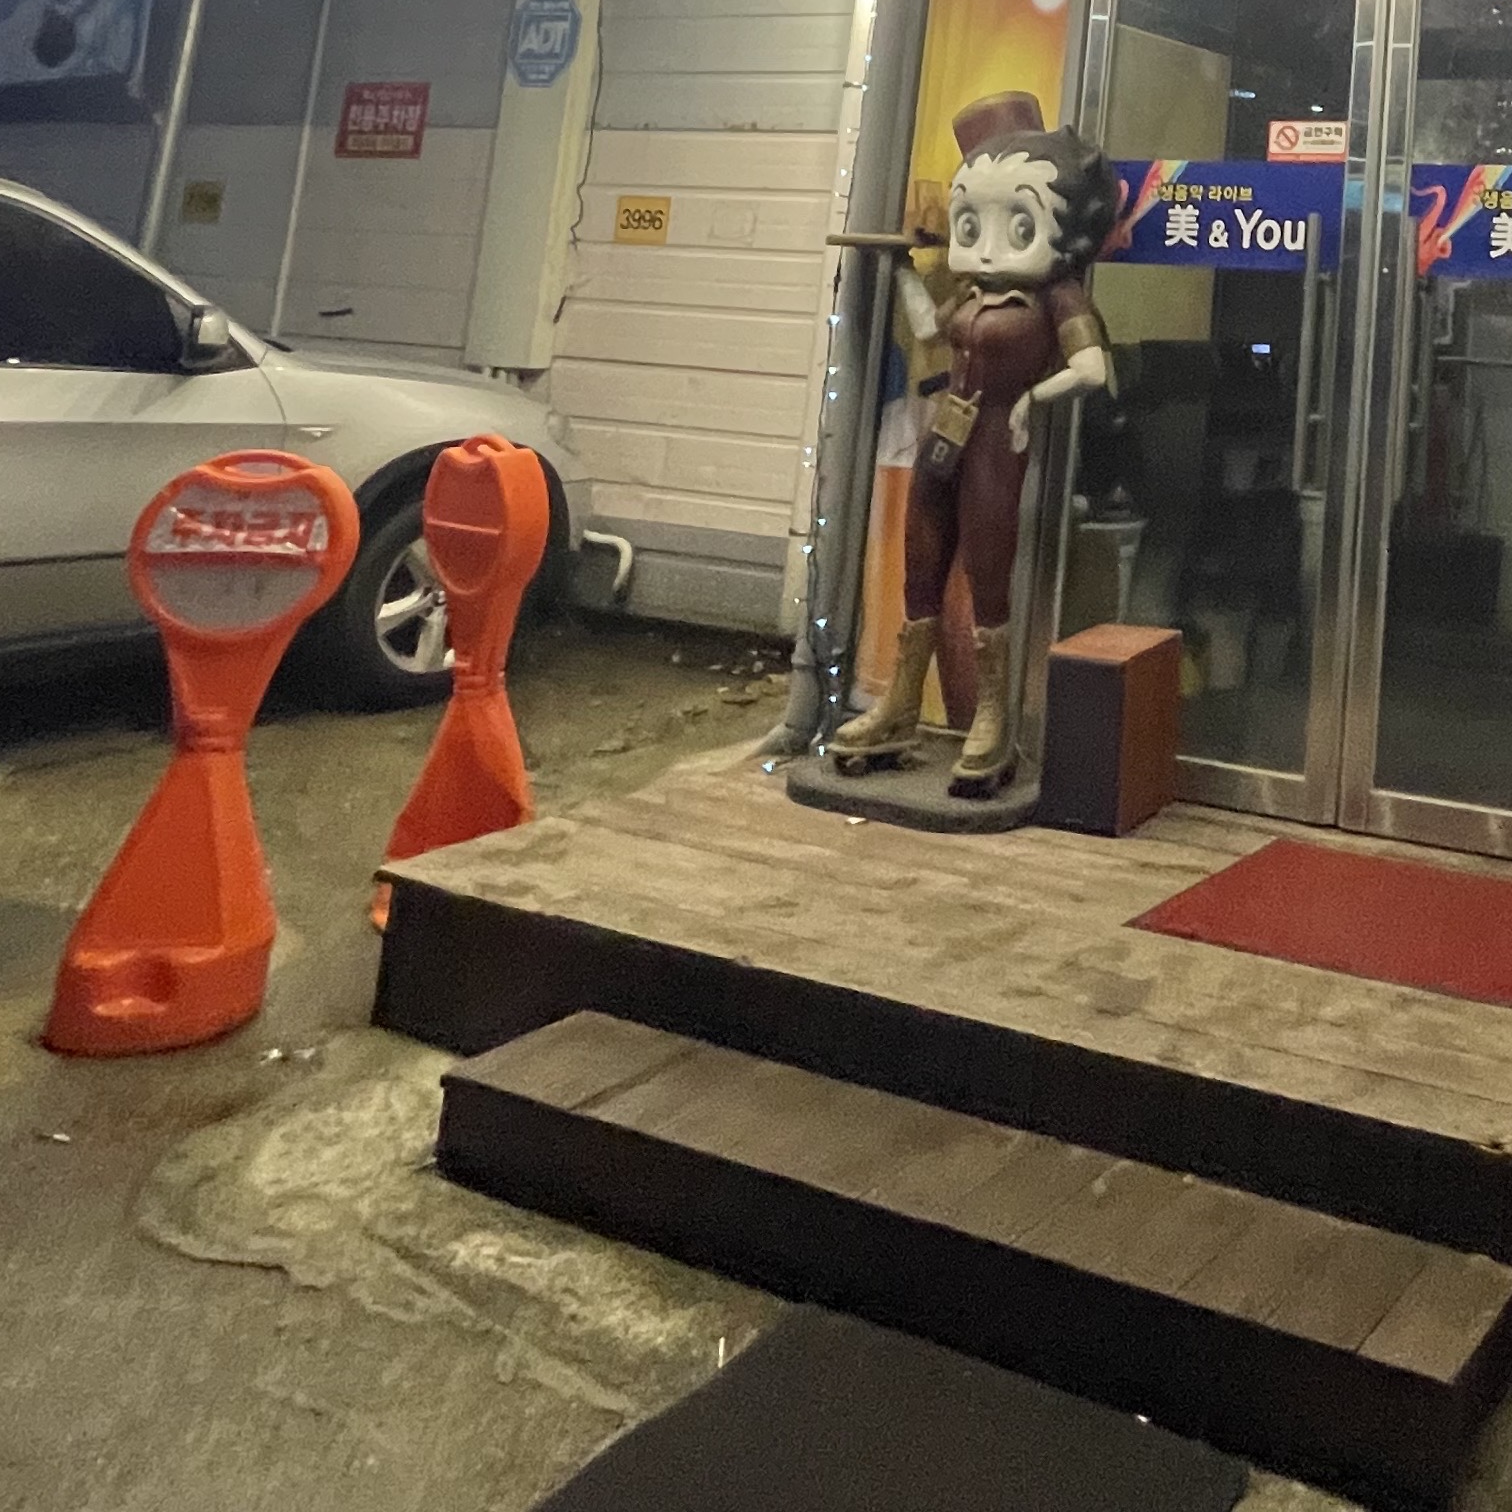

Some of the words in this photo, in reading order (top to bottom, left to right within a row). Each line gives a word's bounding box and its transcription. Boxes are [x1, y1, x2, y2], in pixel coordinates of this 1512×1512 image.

[520, 20, 570, 54] ADT
[1161, 184, 1203, 202] 생음악
[1209, 185, 1253, 203] 라이브
[620, 208, 665, 230] 3996
[1165, 204, 1199, 247] 美
[1208, 220, 1229, 248] &
[1234, 208, 1306, 251] You
